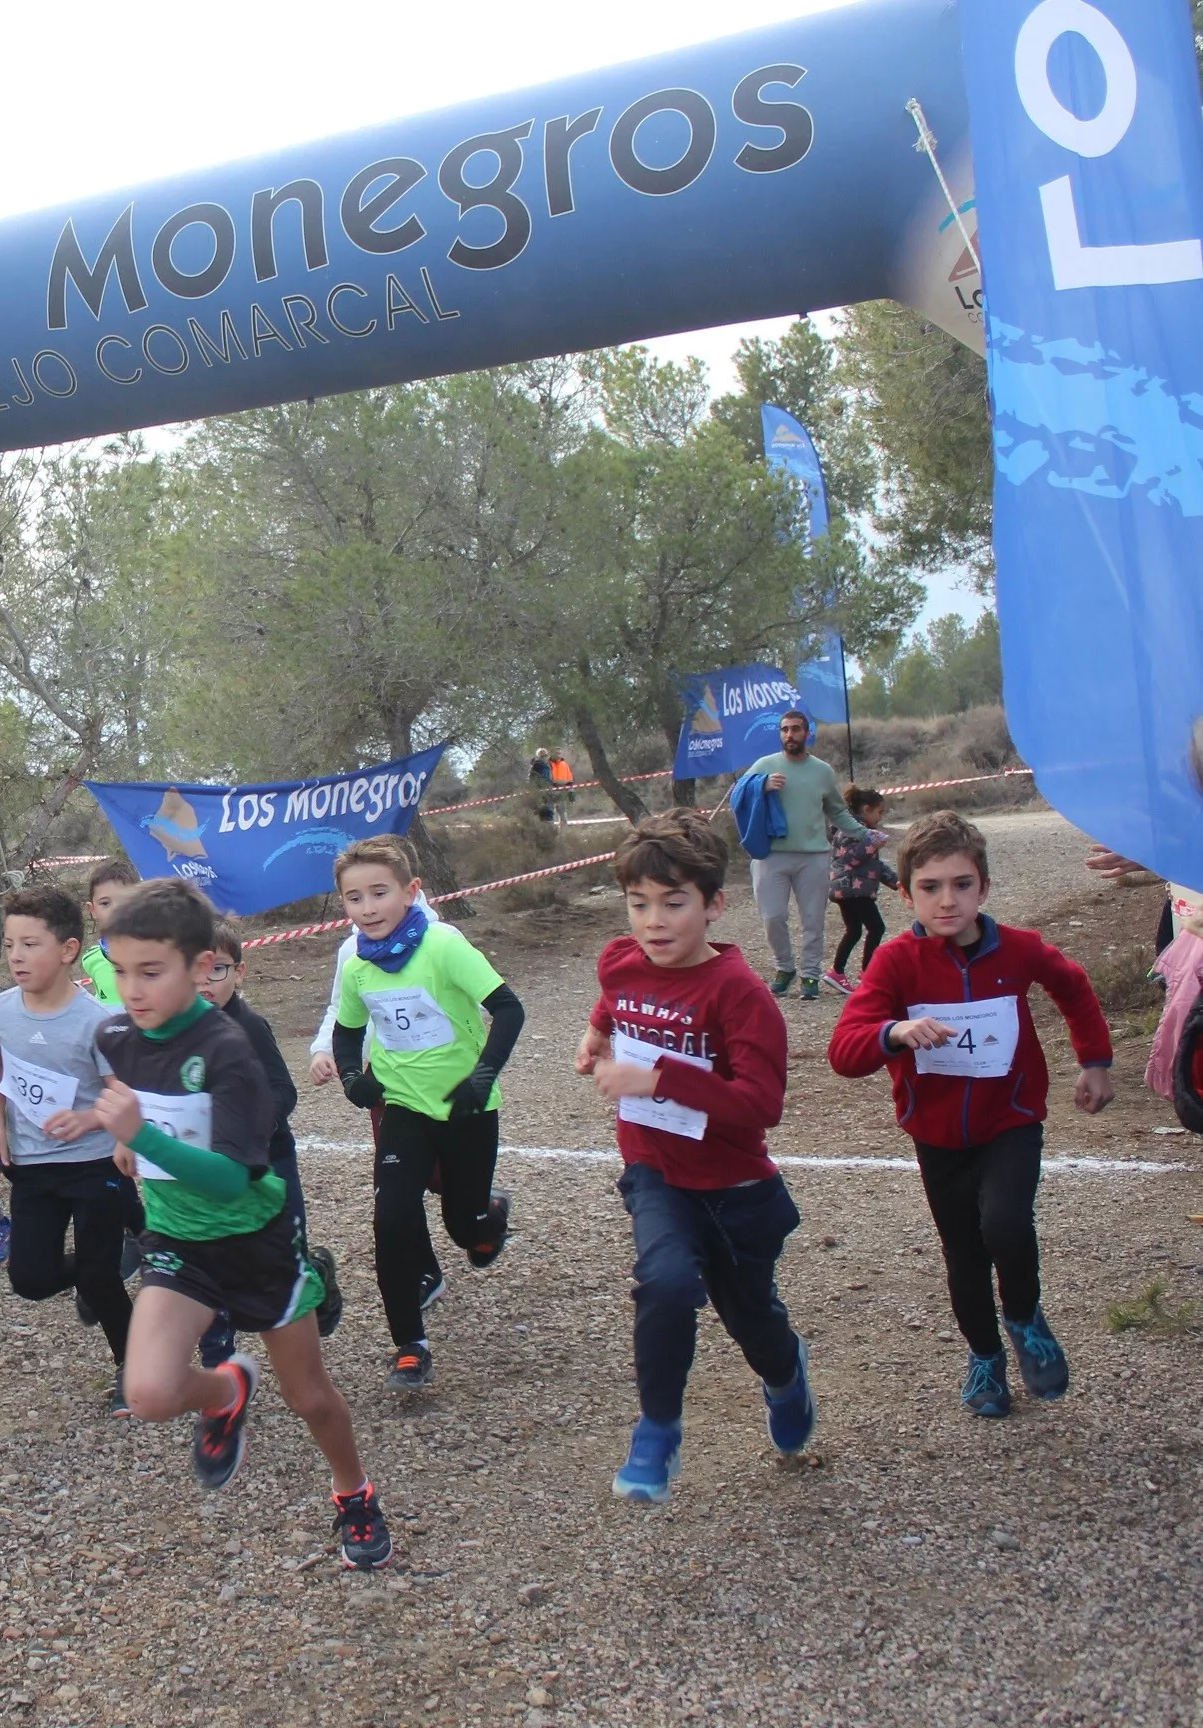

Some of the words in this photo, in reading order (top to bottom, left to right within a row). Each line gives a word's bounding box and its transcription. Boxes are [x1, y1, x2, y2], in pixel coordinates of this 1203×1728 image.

[47, 63, 813, 330] Monegros
[96, 266, 460, 385] COMARCAL
[723, 682, 743, 716] Los
[219, 787, 277, 833] Los
[283, 771, 426, 823] Monegros
[395, 1008, 410, 1030] 5
[965, 1011, 998, 1020] MONEGROS
[957, 1028, 976, 1054] 4
[18, 1077, 43, 1105] 39
